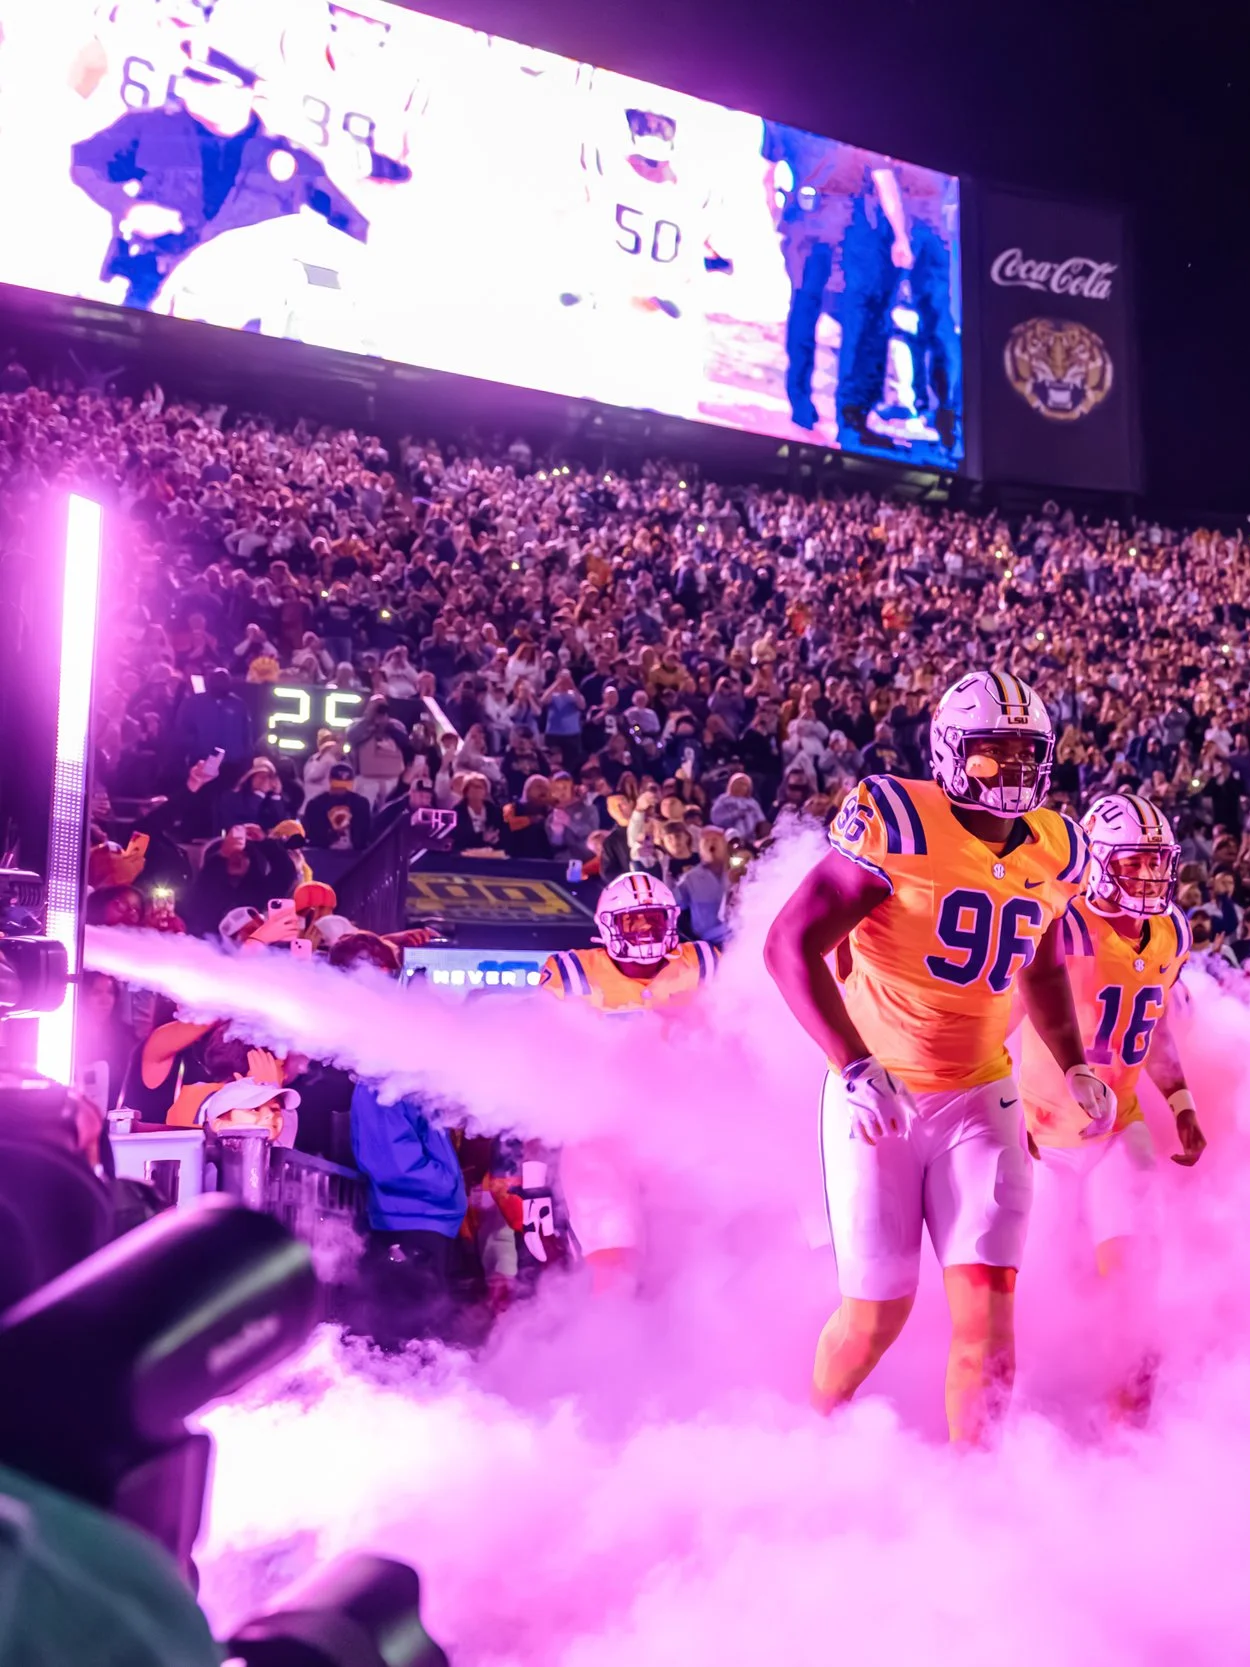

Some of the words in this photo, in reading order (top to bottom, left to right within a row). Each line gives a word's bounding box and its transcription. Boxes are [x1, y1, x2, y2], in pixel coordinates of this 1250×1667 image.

[616, 203, 682, 263] 50
[990, 248, 1118, 300] Coca-Cola
[1007, 716, 1029, 725] LSU
[836, 796, 875, 843] 96
[924, 888, 1043, 994] 96
[1085, 984, 1163, 1067] 16
